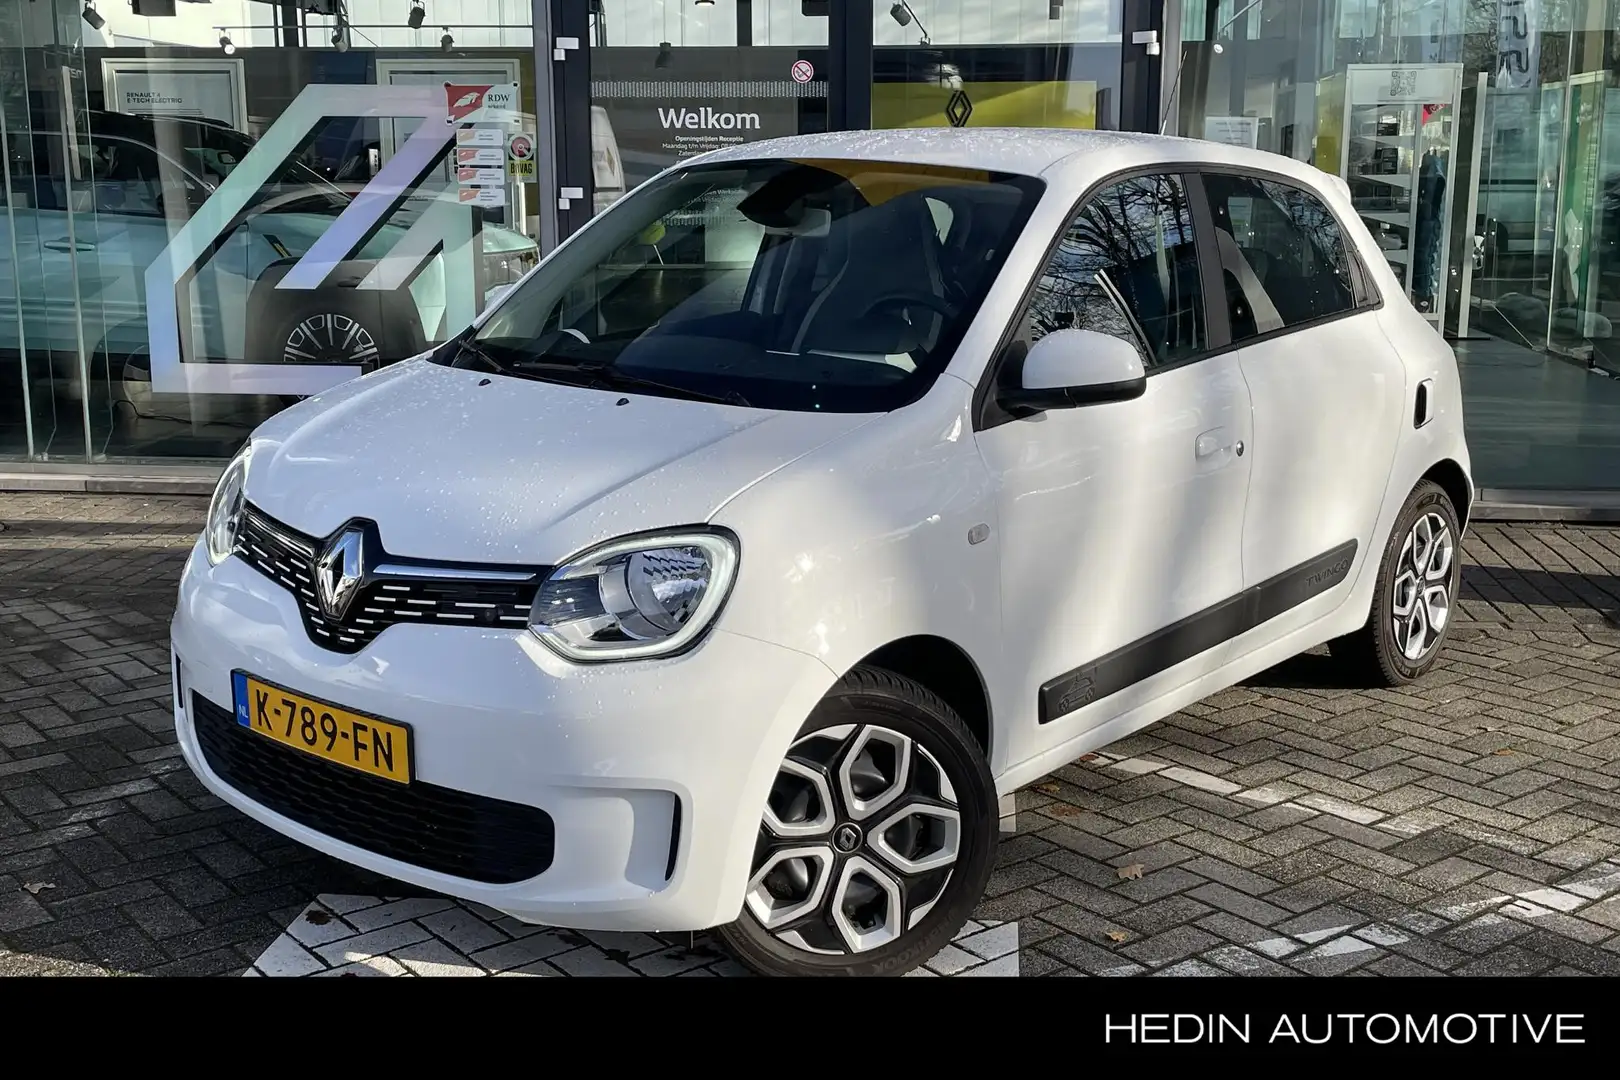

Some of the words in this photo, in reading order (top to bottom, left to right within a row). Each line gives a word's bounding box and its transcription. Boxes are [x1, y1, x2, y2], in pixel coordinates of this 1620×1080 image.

[658, 107, 760, 130] Welkom
[1306, 558, 1348, 586] TWINGO
[238, 704, 249, 718] NL
[256, 688, 394, 772] K-789-FN
